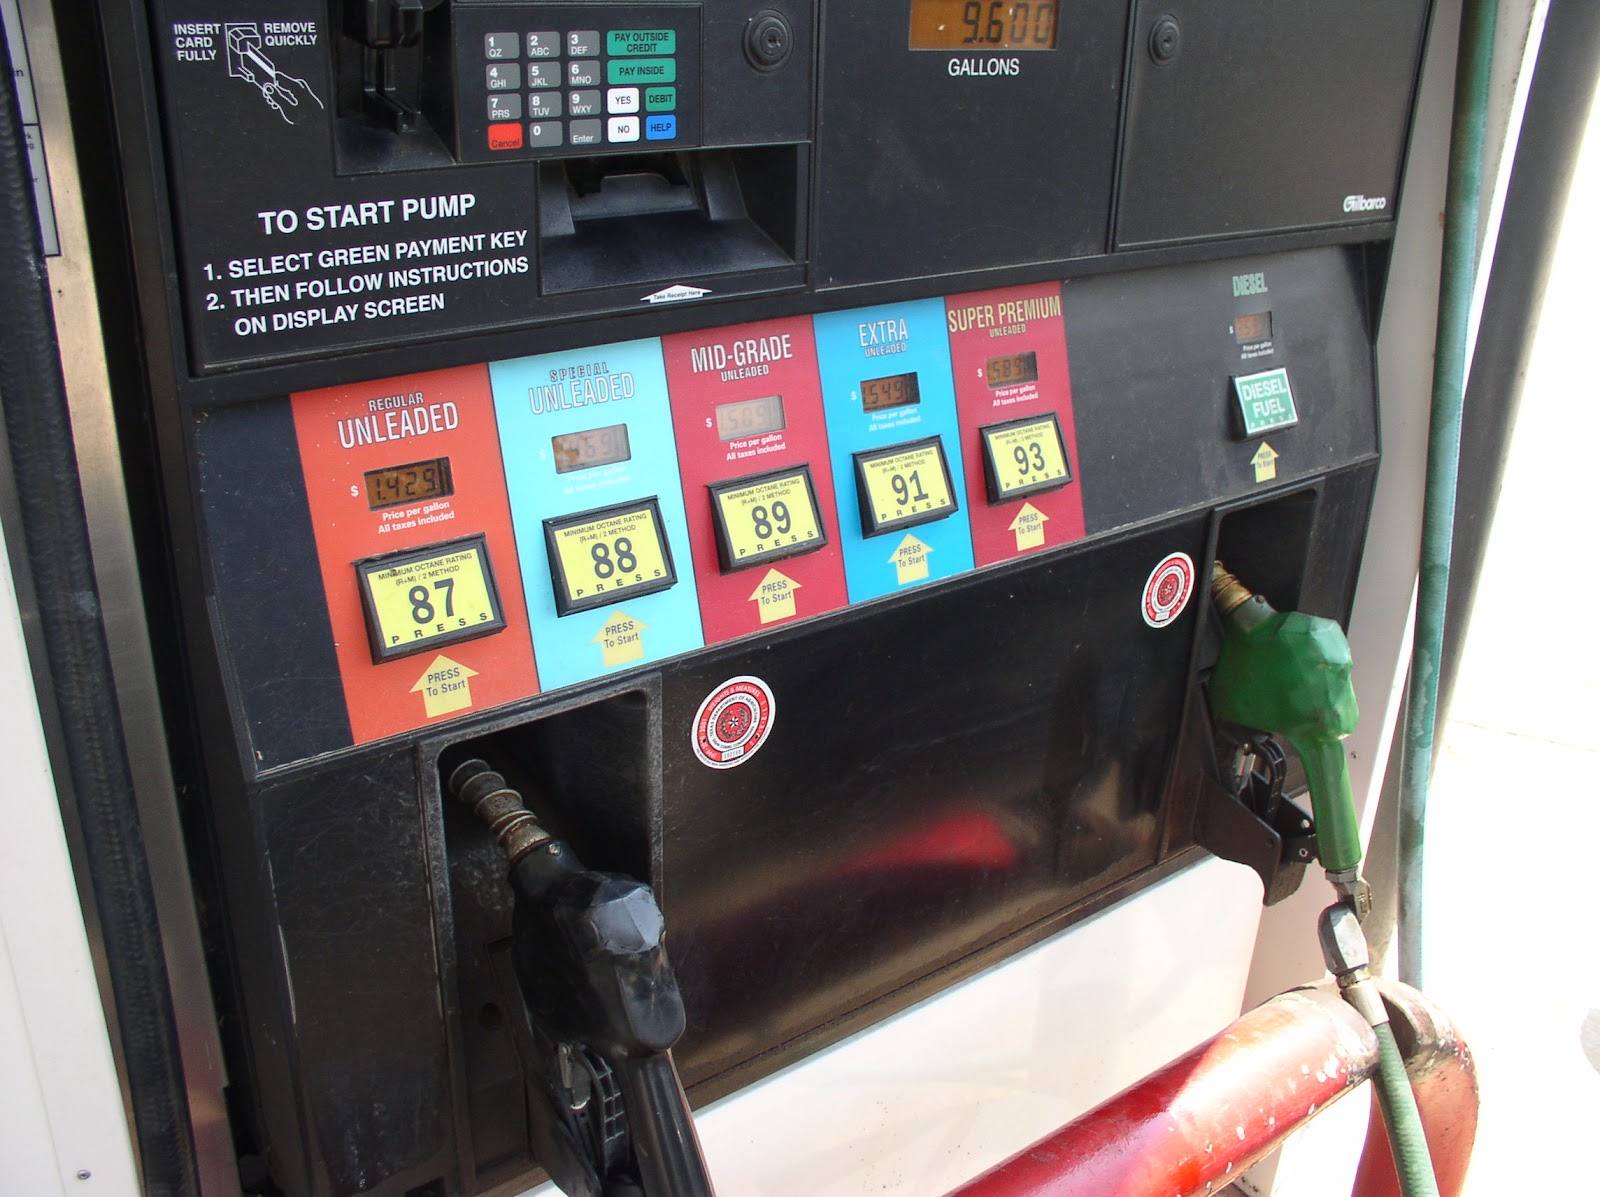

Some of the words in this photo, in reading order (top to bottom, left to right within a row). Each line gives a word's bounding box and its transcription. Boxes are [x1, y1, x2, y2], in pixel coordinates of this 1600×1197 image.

[174, 24, 221, 35] INSERT
[264, 22, 316, 33] REMOVE
[176, 37, 213, 48] CARD
[265, 35, 318, 47] QUICKLY
[488, 37, 495, 47] 1
[530, 35, 538, 46] 2
[571, 34, 579, 45] 3
[615, 33, 631, 42] PAY
[633, 32, 669, 41] OUTSIDE
[489, 48, 502, 57] QZ
[531, 47, 550, 56] ABC
[571, 46, 588, 55] DEF
[627, 44, 657, 53] CREDIT
[177, 50, 217, 61] FULLY
[490, 68, 498, 78] 4
[531, 66, 539, 76] 5
[571, 65, 579, 74] 6
[619, 67, 635, 76] PAY
[637, 66, 664, 75] INSIDE
[948, 58, 1020, 76] GALLONS
[490, 79, 506, 88] GHI
[531, 77, 548, 86] JKL
[572, 76, 591, 85] MNO
[491, 98, 498, 108] 7
[532, 96, 540, 106] 8
[572, 94, 580, 104] 9
[615, 96, 631, 105] YES
[649, 94, 673, 103] DEBIT
[491, 109, 510, 118] PRS
[533, 107, 550, 116] TUV
[572, 105, 592, 114] WXY
[533, 126, 541, 136] 0
[617, 125, 630, 134] NO
[651, 123, 672, 132] HELP
[492, 139, 520, 148] Cancel
[573, 135, 594, 143] Enter
[258, 210, 298, 234] TO
[306, 201, 395, 231] START
[402, 193, 476, 221] PUMP
[203, 263, 222, 281] 1.
[228, 253, 313, 279] SELECT
[318, 243, 390, 268] GREEN
[395, 234, 486, 260] PAYMENT
[490, 230, 528, 249] KEY
[206, 294, 225, 311] 2.
[231, 285, 290, 308] THEN
[295, 272, 384, 299] FOLLOW
[389, 257, 529, 288] INSTRUCTIONS
[1232, 272, 1268, 297] DIESEL
[234, 316, 267, 336] ON
[273, 304, 359, 332] DISPLAY
[364, 292, 445, 319] SCREEN
[948, 305, 995, 332] SUPER
[998, 295, 1061, 324] PREMIUM
[859, 319, 909, 347] EXTRA
[989, 324, 1027, 338] UNLEADED
[690, 334, 793, 373] MID-GRADE
[864, 342, 907, 358] UNLEADED
[550, 362, 610, 382] SPECIAL
[721, 364, 769, 381] UNLEADED
[977, 368, 983, 378] $
[528, 372, 635, 415] UNLEADED
[1241, 378, 1287, 401] DIESEL
[368, 392, 424, 412] REGULAR
[1253, 398, 1286, 418] FUEL
[337, 401, 459, 449] UNLEADED
[706, 417, 712, 428] $
[730, 441, 747, 450] Price
[748, 438, 760, 447] per
[761, 434, 782, 444] gallon
[757, 442, 786, 455] included
[1014, 442, 1045, 475] 93
[350, 485, 359, 498] $
[891, 470, 929, 506] 91
[382, 510, 405, 522] Price
[406, 508, 421, 519] per
[423, 501, 450, 515] gallon
[378, 524, 391, 534] All
[392, 519, 417, 531] taxes
[418, 511, 455, 526] included
[752, 500, 791, 539] 89
[1019, 513, 1038, 524] PRESS
[564, 524, 595, 538] MINIMUM
[596, 519, 623, 530] OCTANE
[624, 513, 647, 524] RATING
[608, 524, 636, 536] METHOD
[739, 530, 814, 556] PRESS
[899, 544, 922, 556] PRESS
[591, 537, 637, 579] 88
[908, 554, 925, 565] Start
[378, 567, 413, 580] MINIMUM
[415, 559, 444, 573] OCTANE
[445, 553, 472, 563] RATING
[396, 576, 417, 587] (R+M)
[428, 565, 460, 578] METHOD
[576, 569, 661, 597] PRESS
[762, 580, 787, 594] PRESS
[409, 577, 455, 624] 87
[761, 597, 770, 605] To
[772, 591, 792, 602] Start
[392, 612, 487, 644] PRESS
[605, 621, 634, 636] PRESS
[604, 639, 614, 648] To
[617, 632, 639, 645] Start
[427, 667, 460, 684] PRESS
[426, 686, 439, 697] To
[441, 680, 466, 694] Start
